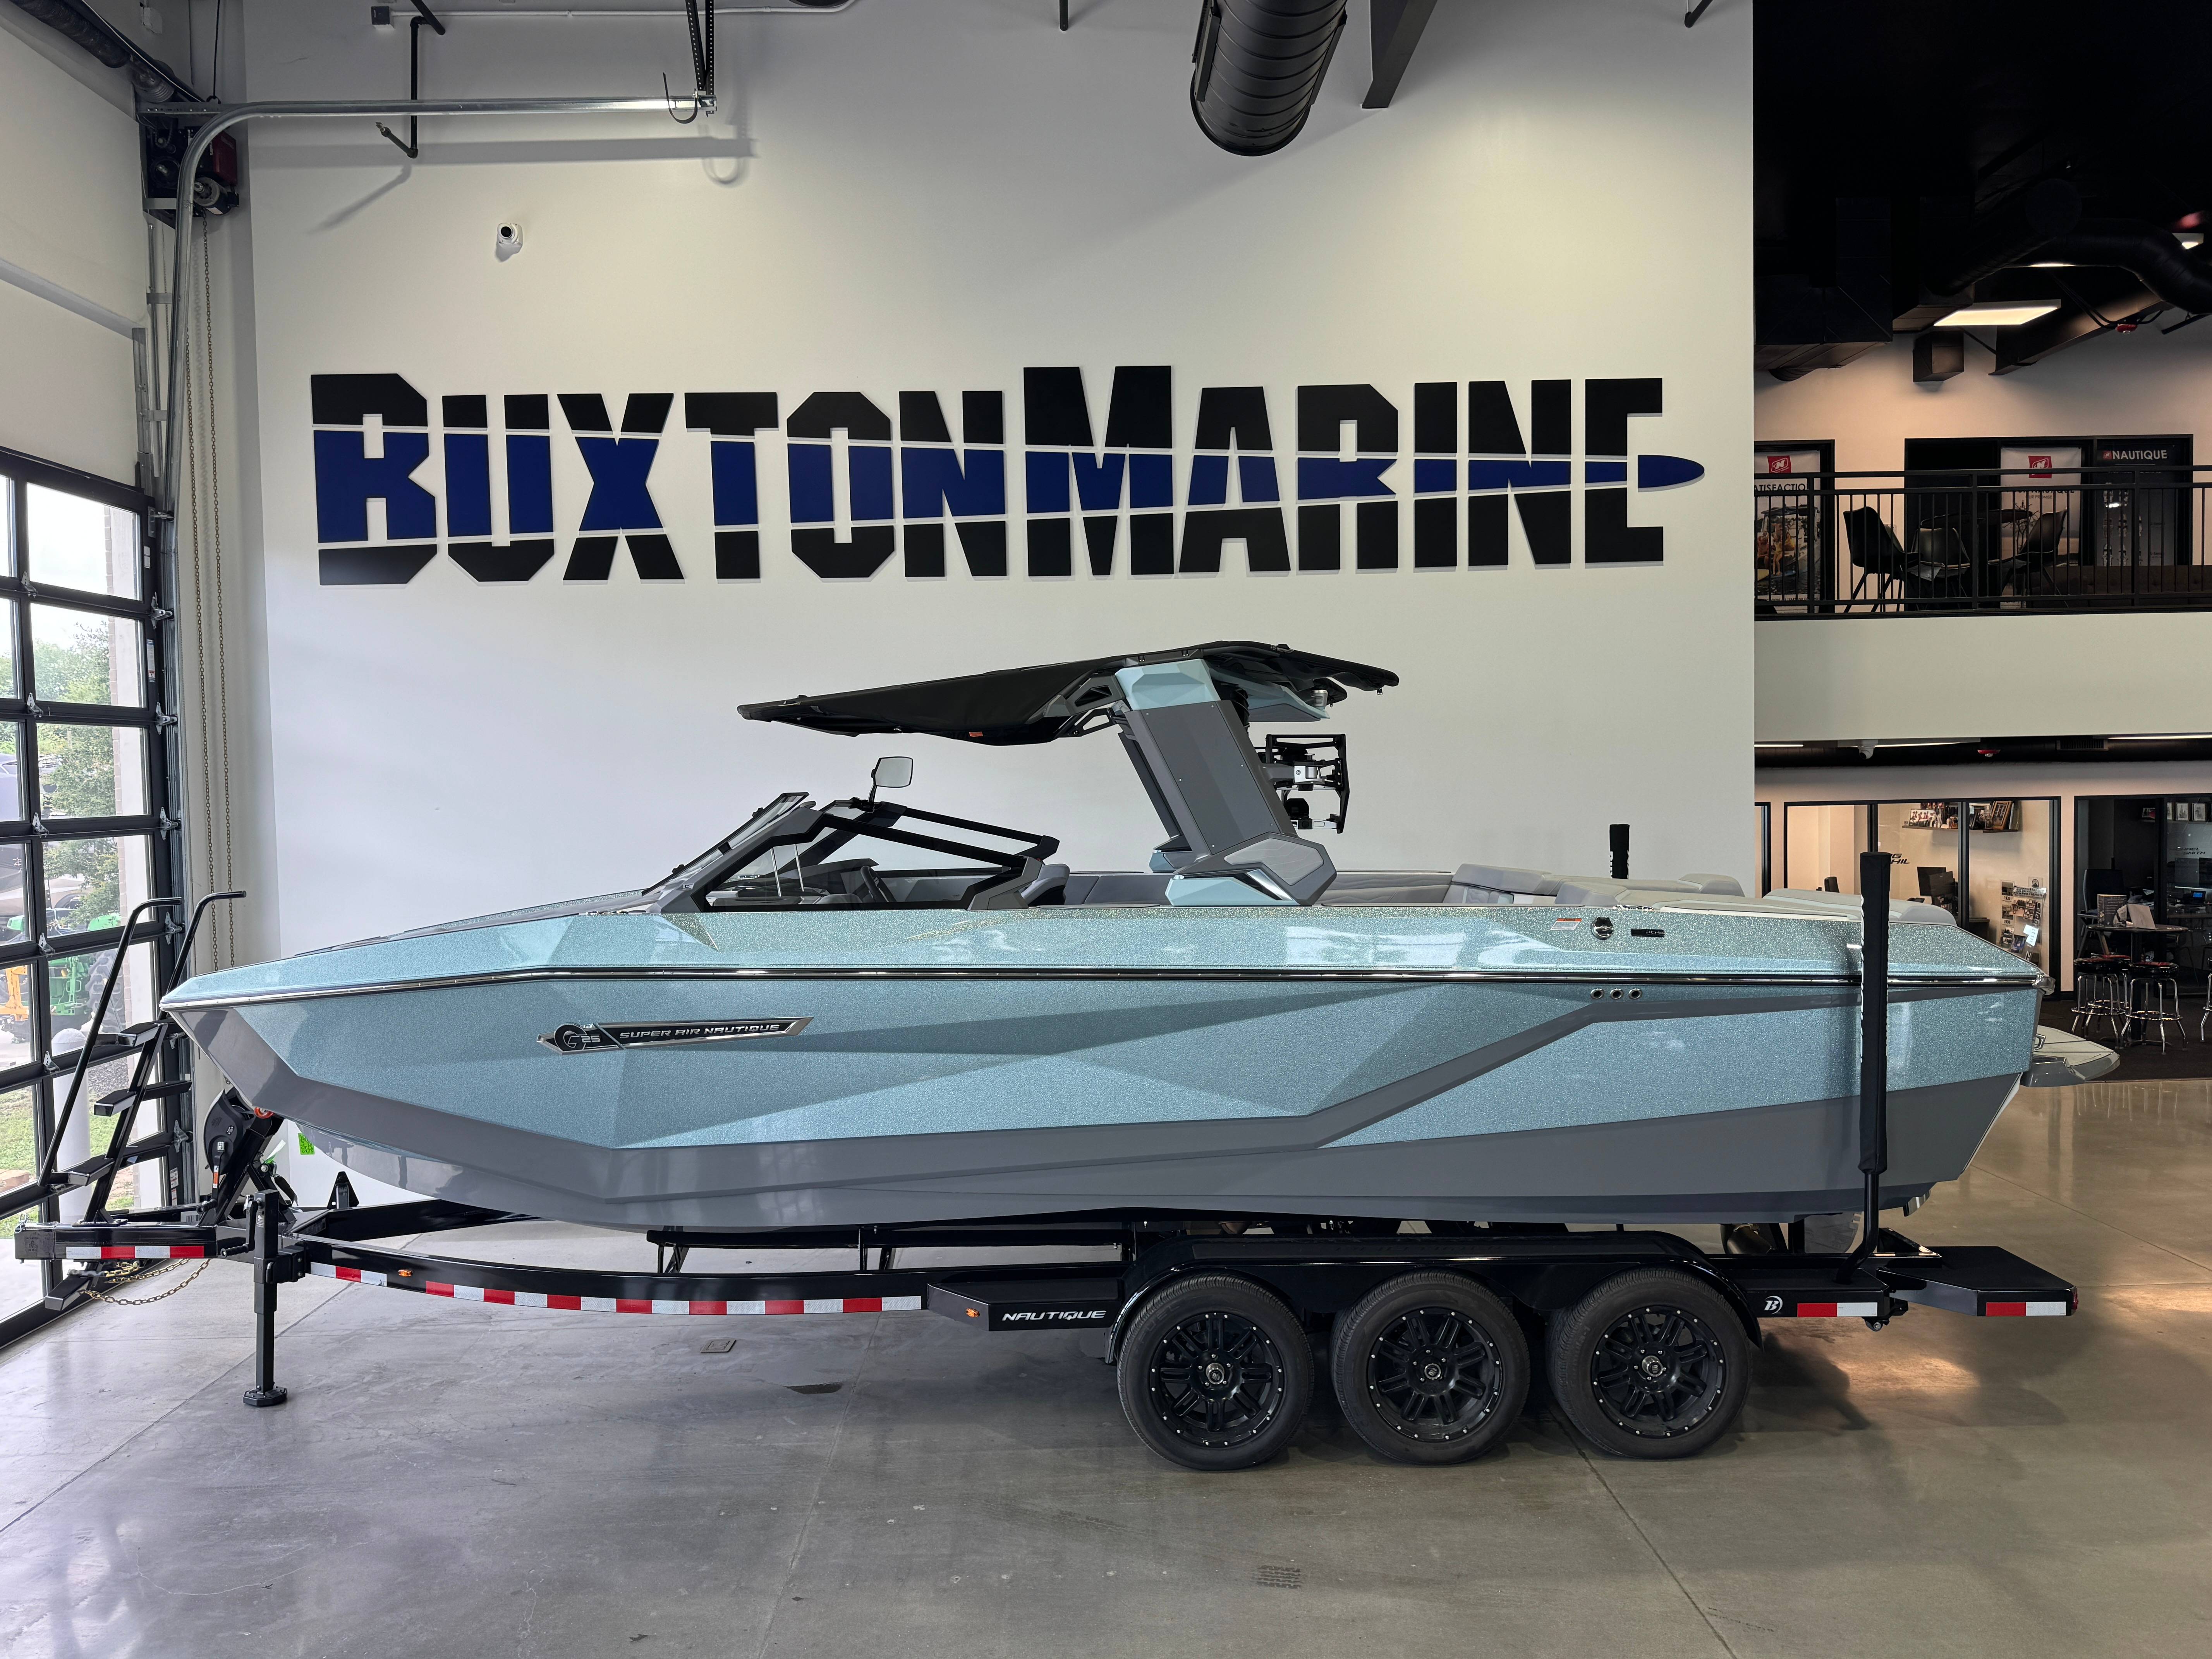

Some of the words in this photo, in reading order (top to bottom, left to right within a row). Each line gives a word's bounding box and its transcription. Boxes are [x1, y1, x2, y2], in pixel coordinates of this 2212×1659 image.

[2112, 450, 2167, 460] NAUTIQUE
[1754, 483, 1806, 491] ATISFACTIO
[620, 1030, 671, 1038] SUPER
[704, 1024, 780, 1034] NAUTIQUE
[1001, 1310, 1107, 1321] NAUTIQUE
